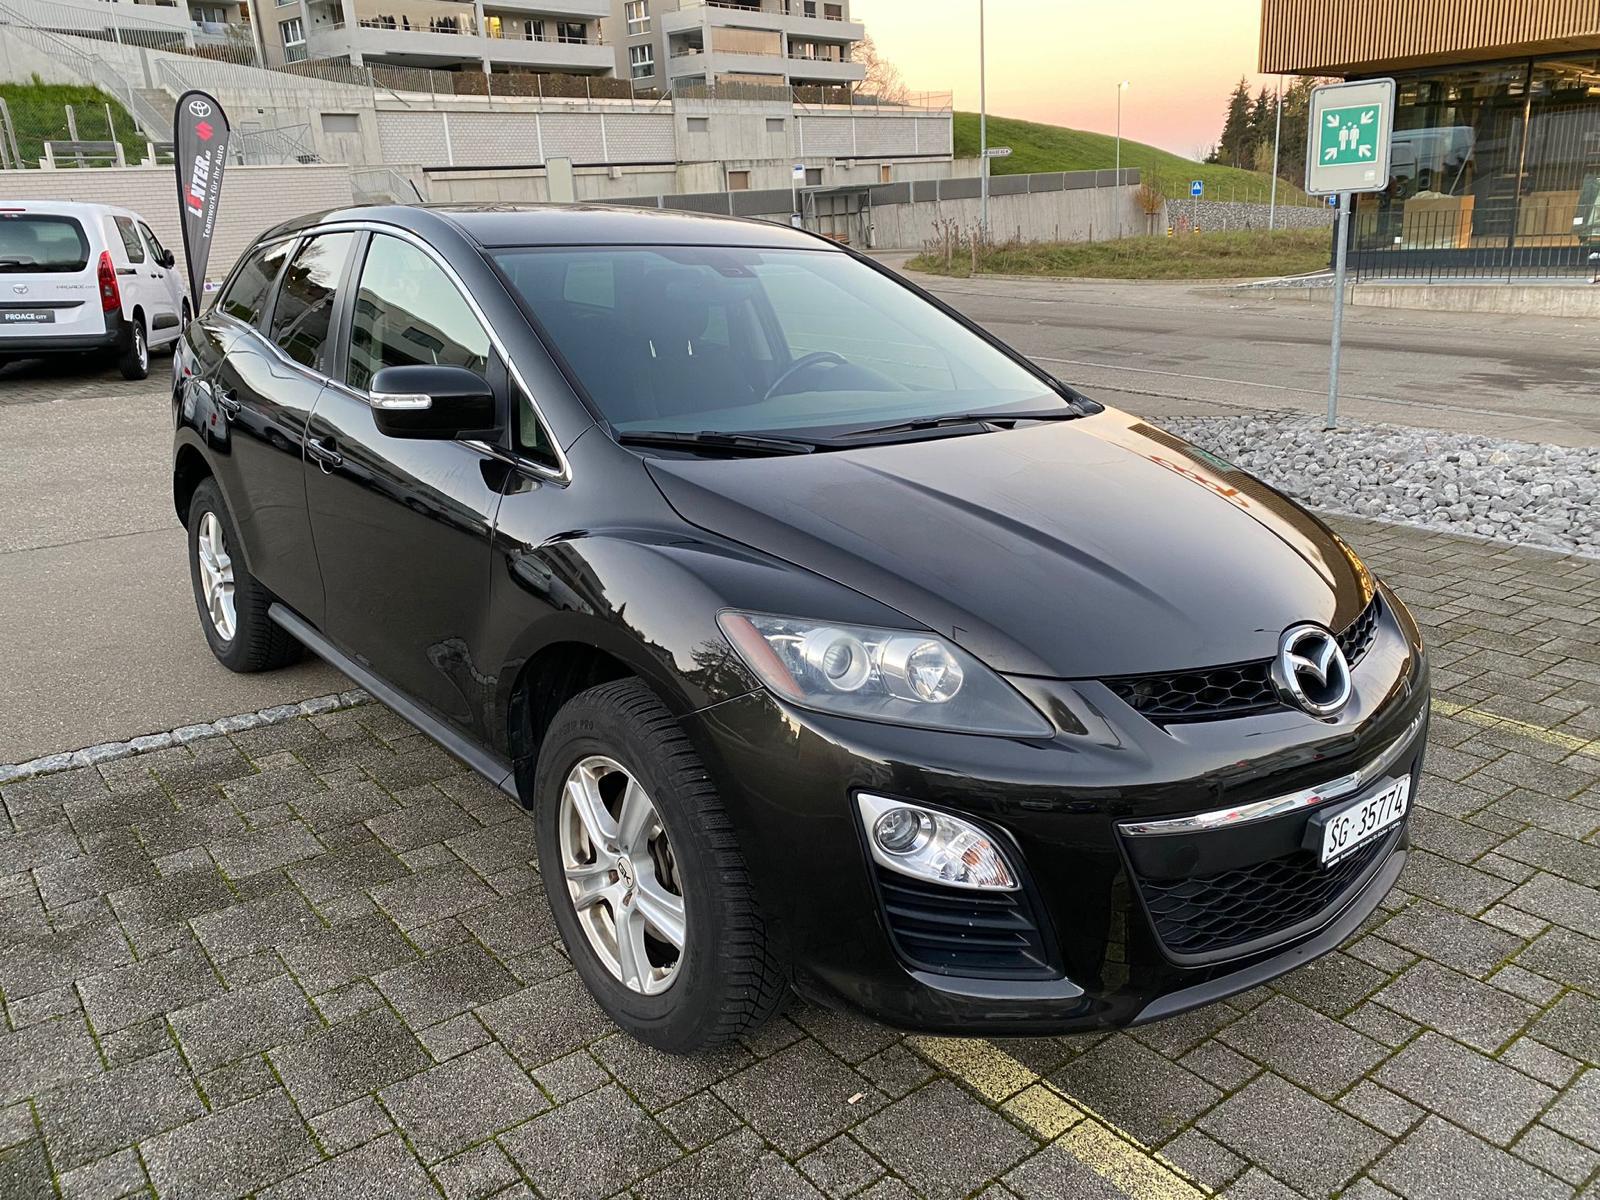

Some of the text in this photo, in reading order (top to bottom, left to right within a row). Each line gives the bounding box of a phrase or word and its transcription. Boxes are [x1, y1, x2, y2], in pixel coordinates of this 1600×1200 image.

[203, 195, 216, 238] Teamwork
[210, 179, 218, 194] für
[215, 145, 224, 166] Auto
[1328, 785, 1403, 853] SG 35774
